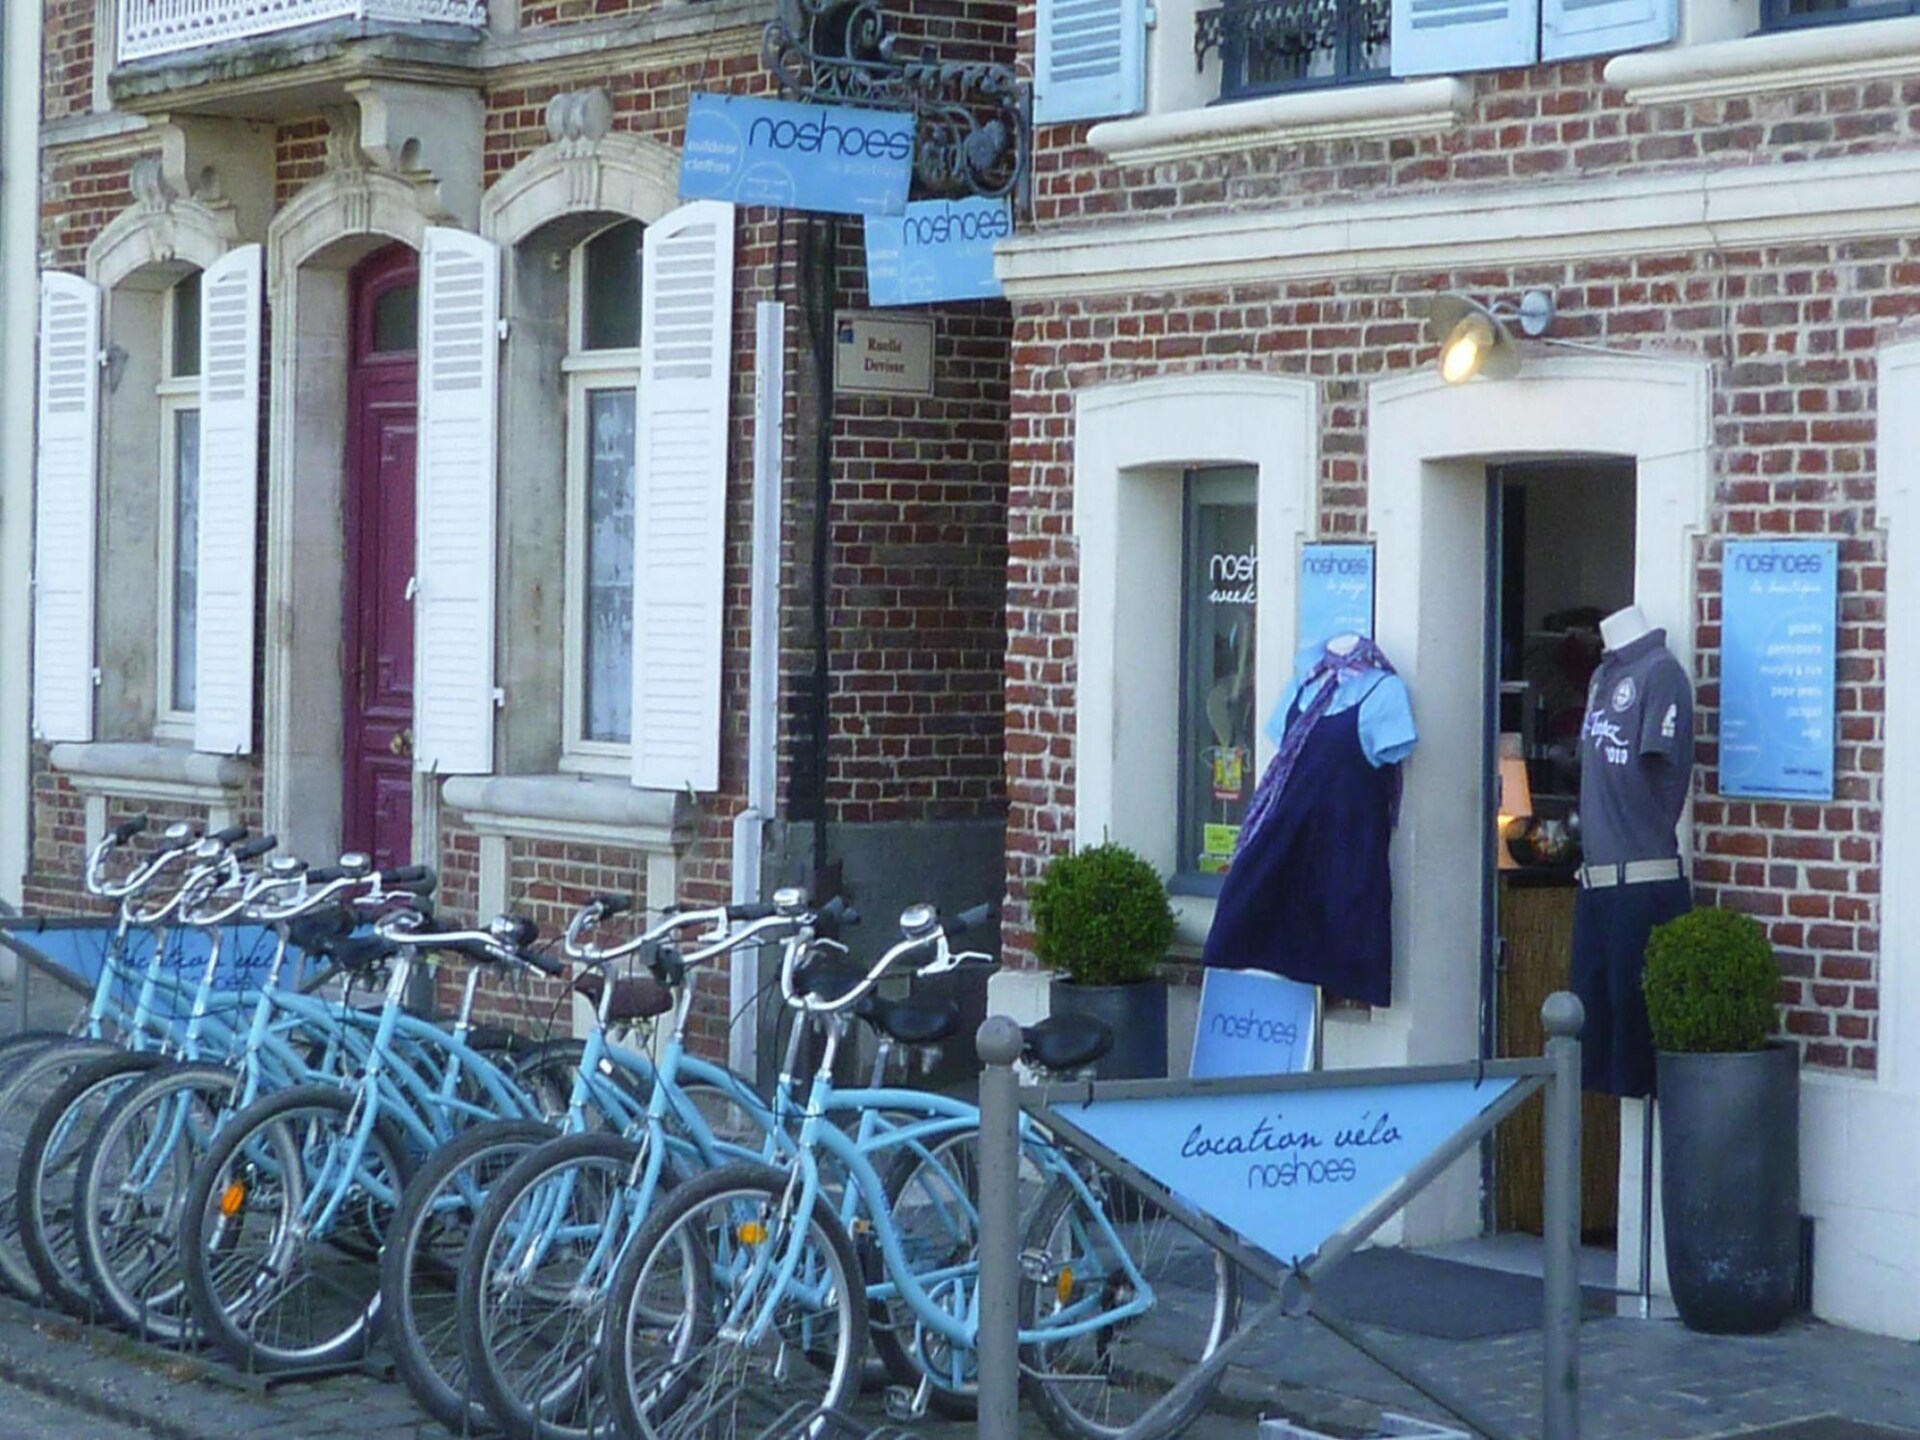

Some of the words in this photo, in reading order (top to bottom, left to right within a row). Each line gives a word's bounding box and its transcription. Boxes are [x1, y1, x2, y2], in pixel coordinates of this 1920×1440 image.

[749, 111, 911, 161] noshoes
[902, 202, 1009, 246] noshoes
[1303, 552, 1369, 575] noshoes
[1735, 547, 1823, 573] noshoes
[1211, 1008, 1297, 1046] noshoes
[1181, 1113, 1322, 1158] location
[1334, 1110, 1402, 1148] vélo
[1248, 1151, 1357, 1189] noshoes
